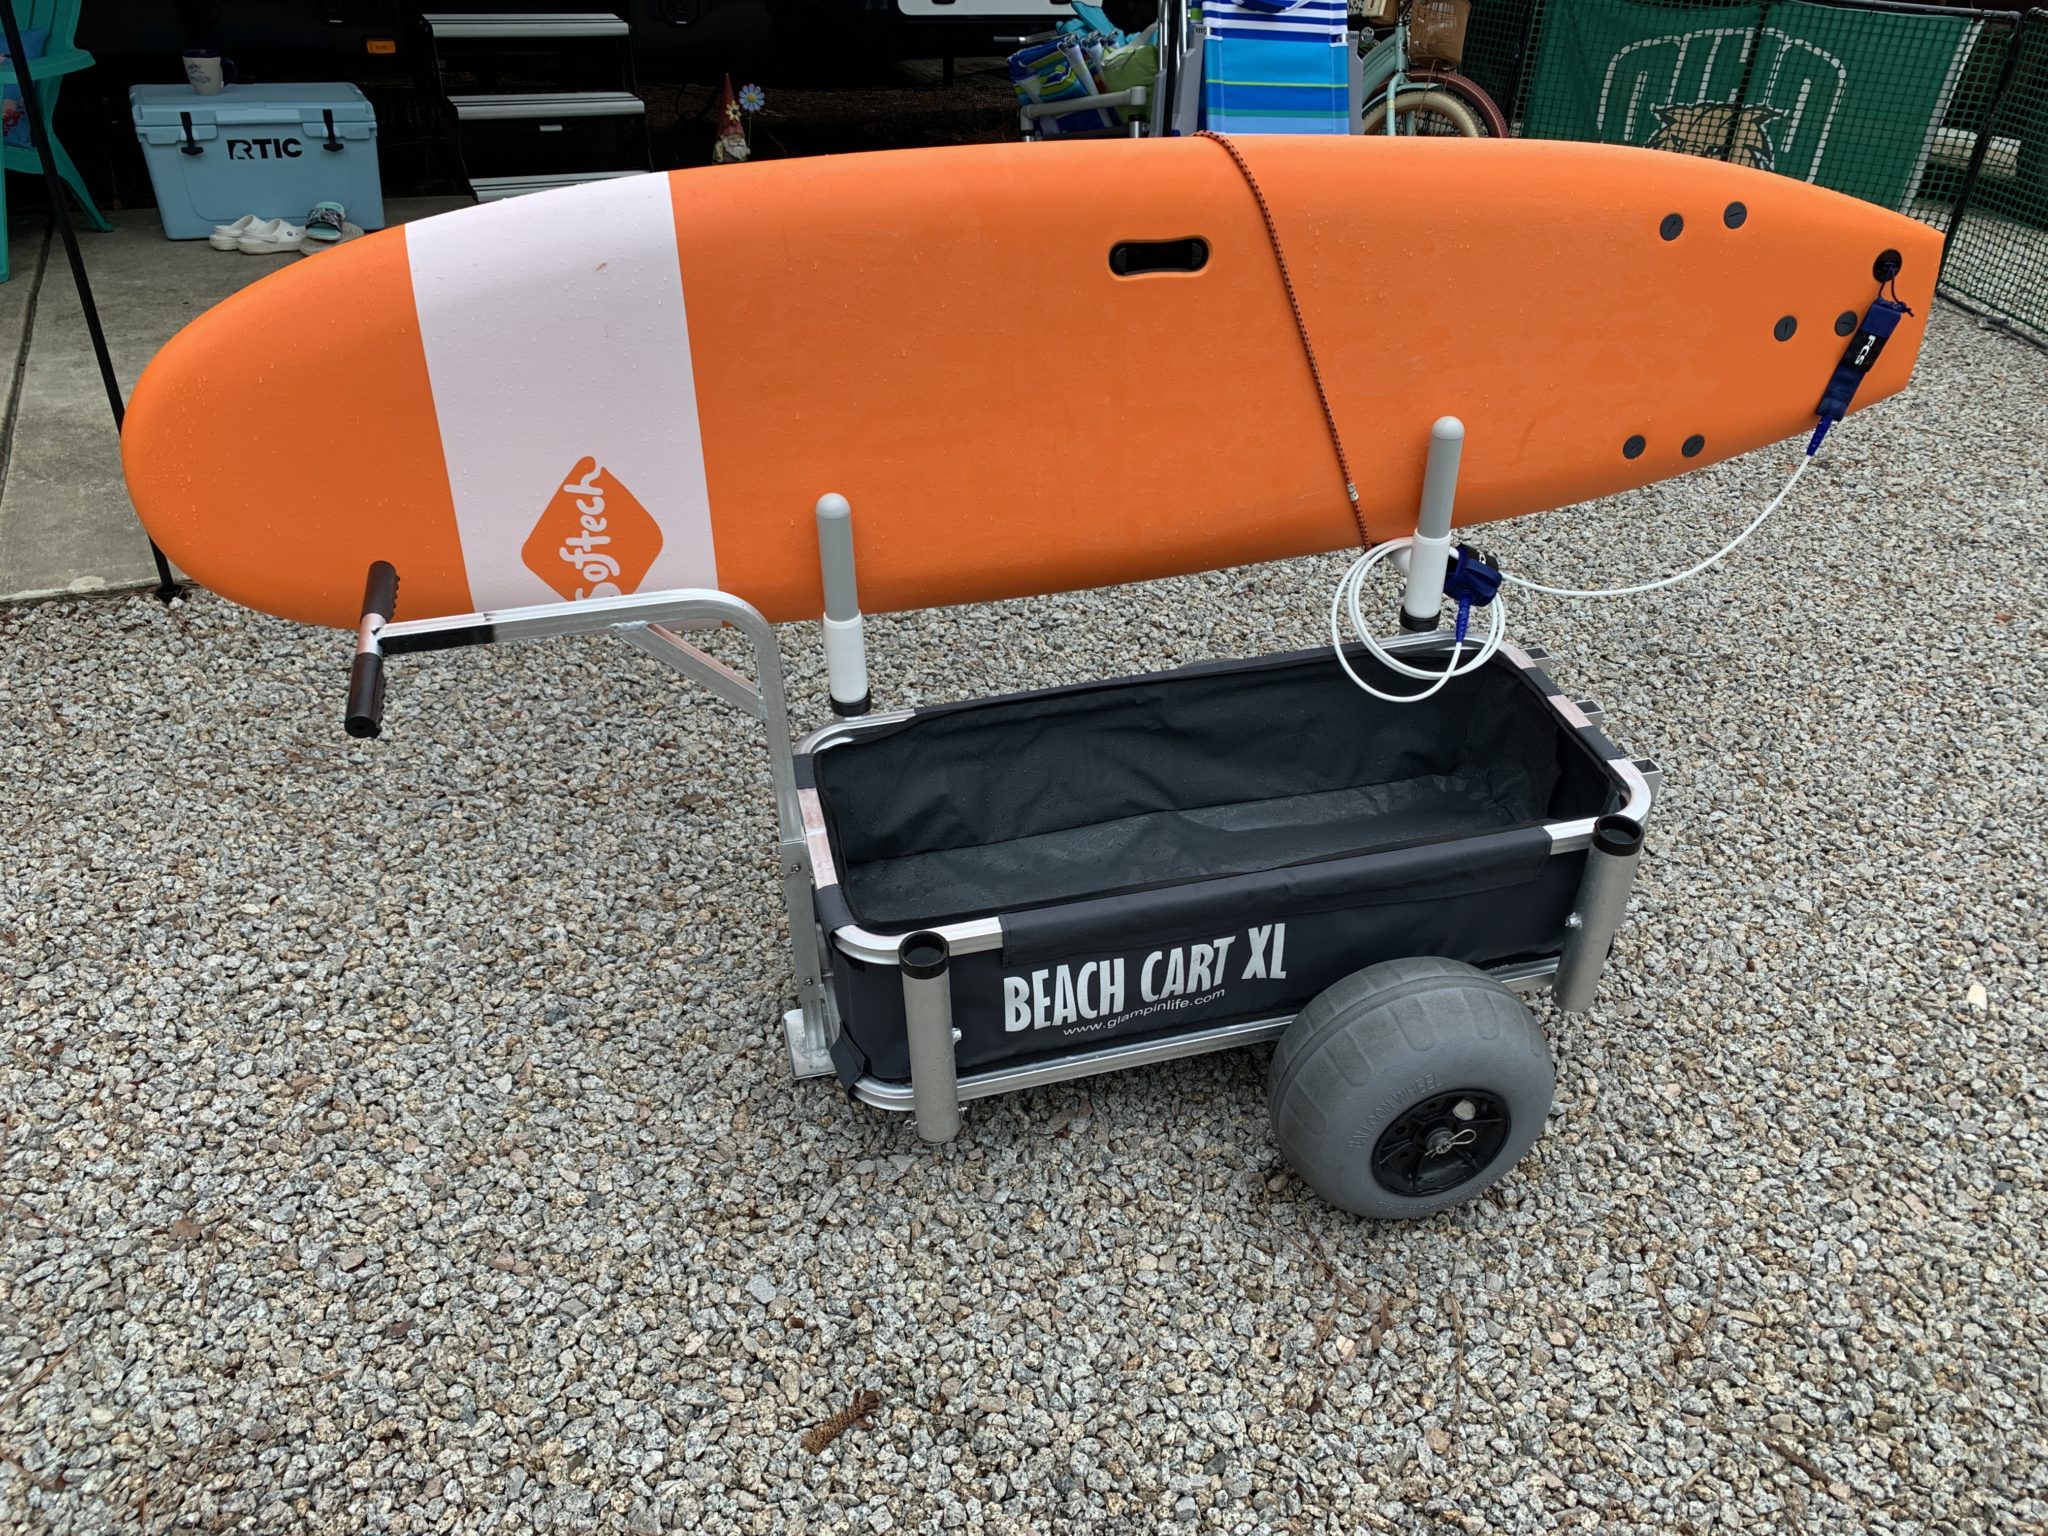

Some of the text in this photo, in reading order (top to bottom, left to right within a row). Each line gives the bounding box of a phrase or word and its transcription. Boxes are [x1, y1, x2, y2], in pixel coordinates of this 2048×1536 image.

[226, 138, 303, 160] RTIC
[1854, 335, 1876, 365] FCS
[1003, 922, 1287, 1032] BEACH CART XL
[1063, 988, 1226, 1036] www.glampinlife.com
[1392, 1072, 1443, 1106] WHEEL
